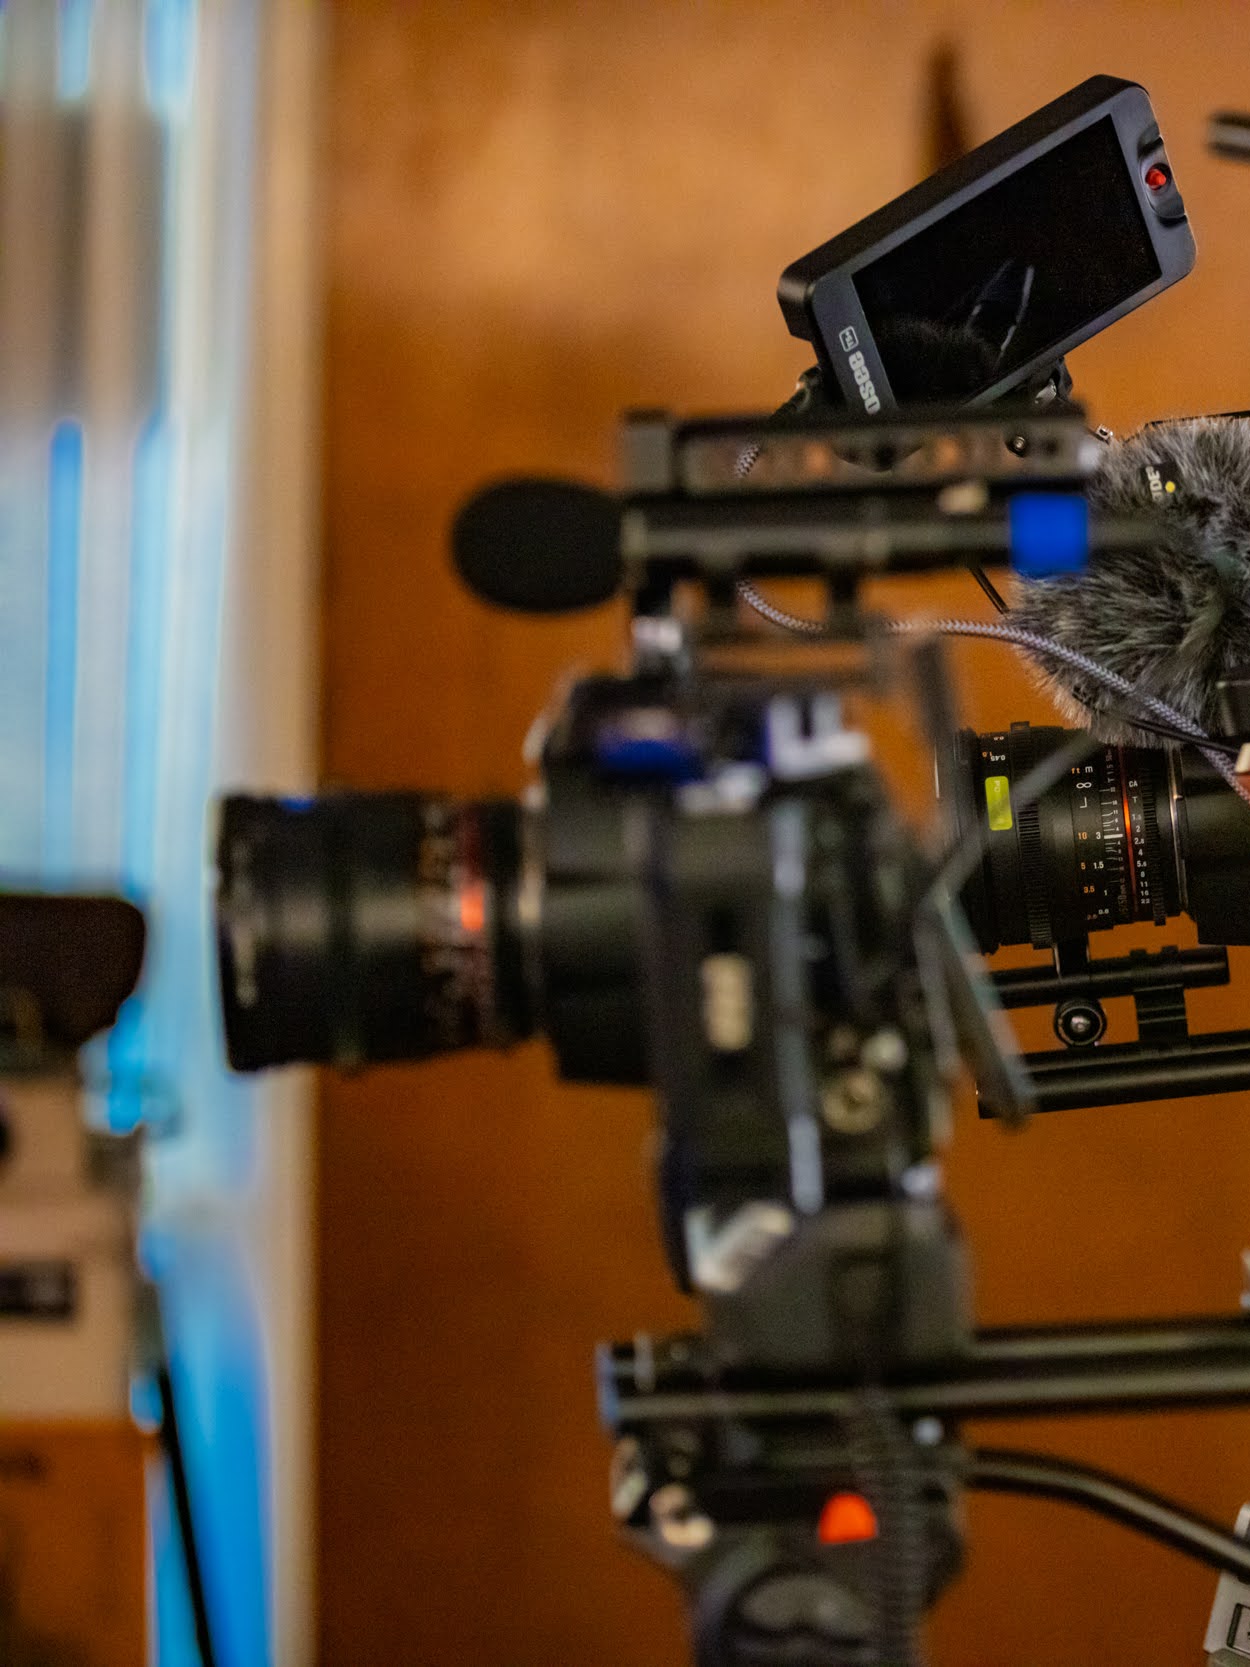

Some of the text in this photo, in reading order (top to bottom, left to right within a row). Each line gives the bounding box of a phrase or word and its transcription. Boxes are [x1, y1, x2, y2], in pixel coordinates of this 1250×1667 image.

[849, 350, 881, 415] osee
[1096, 832, 1101, 840] 3
[1093, 861, 1105, 870] 1.5
